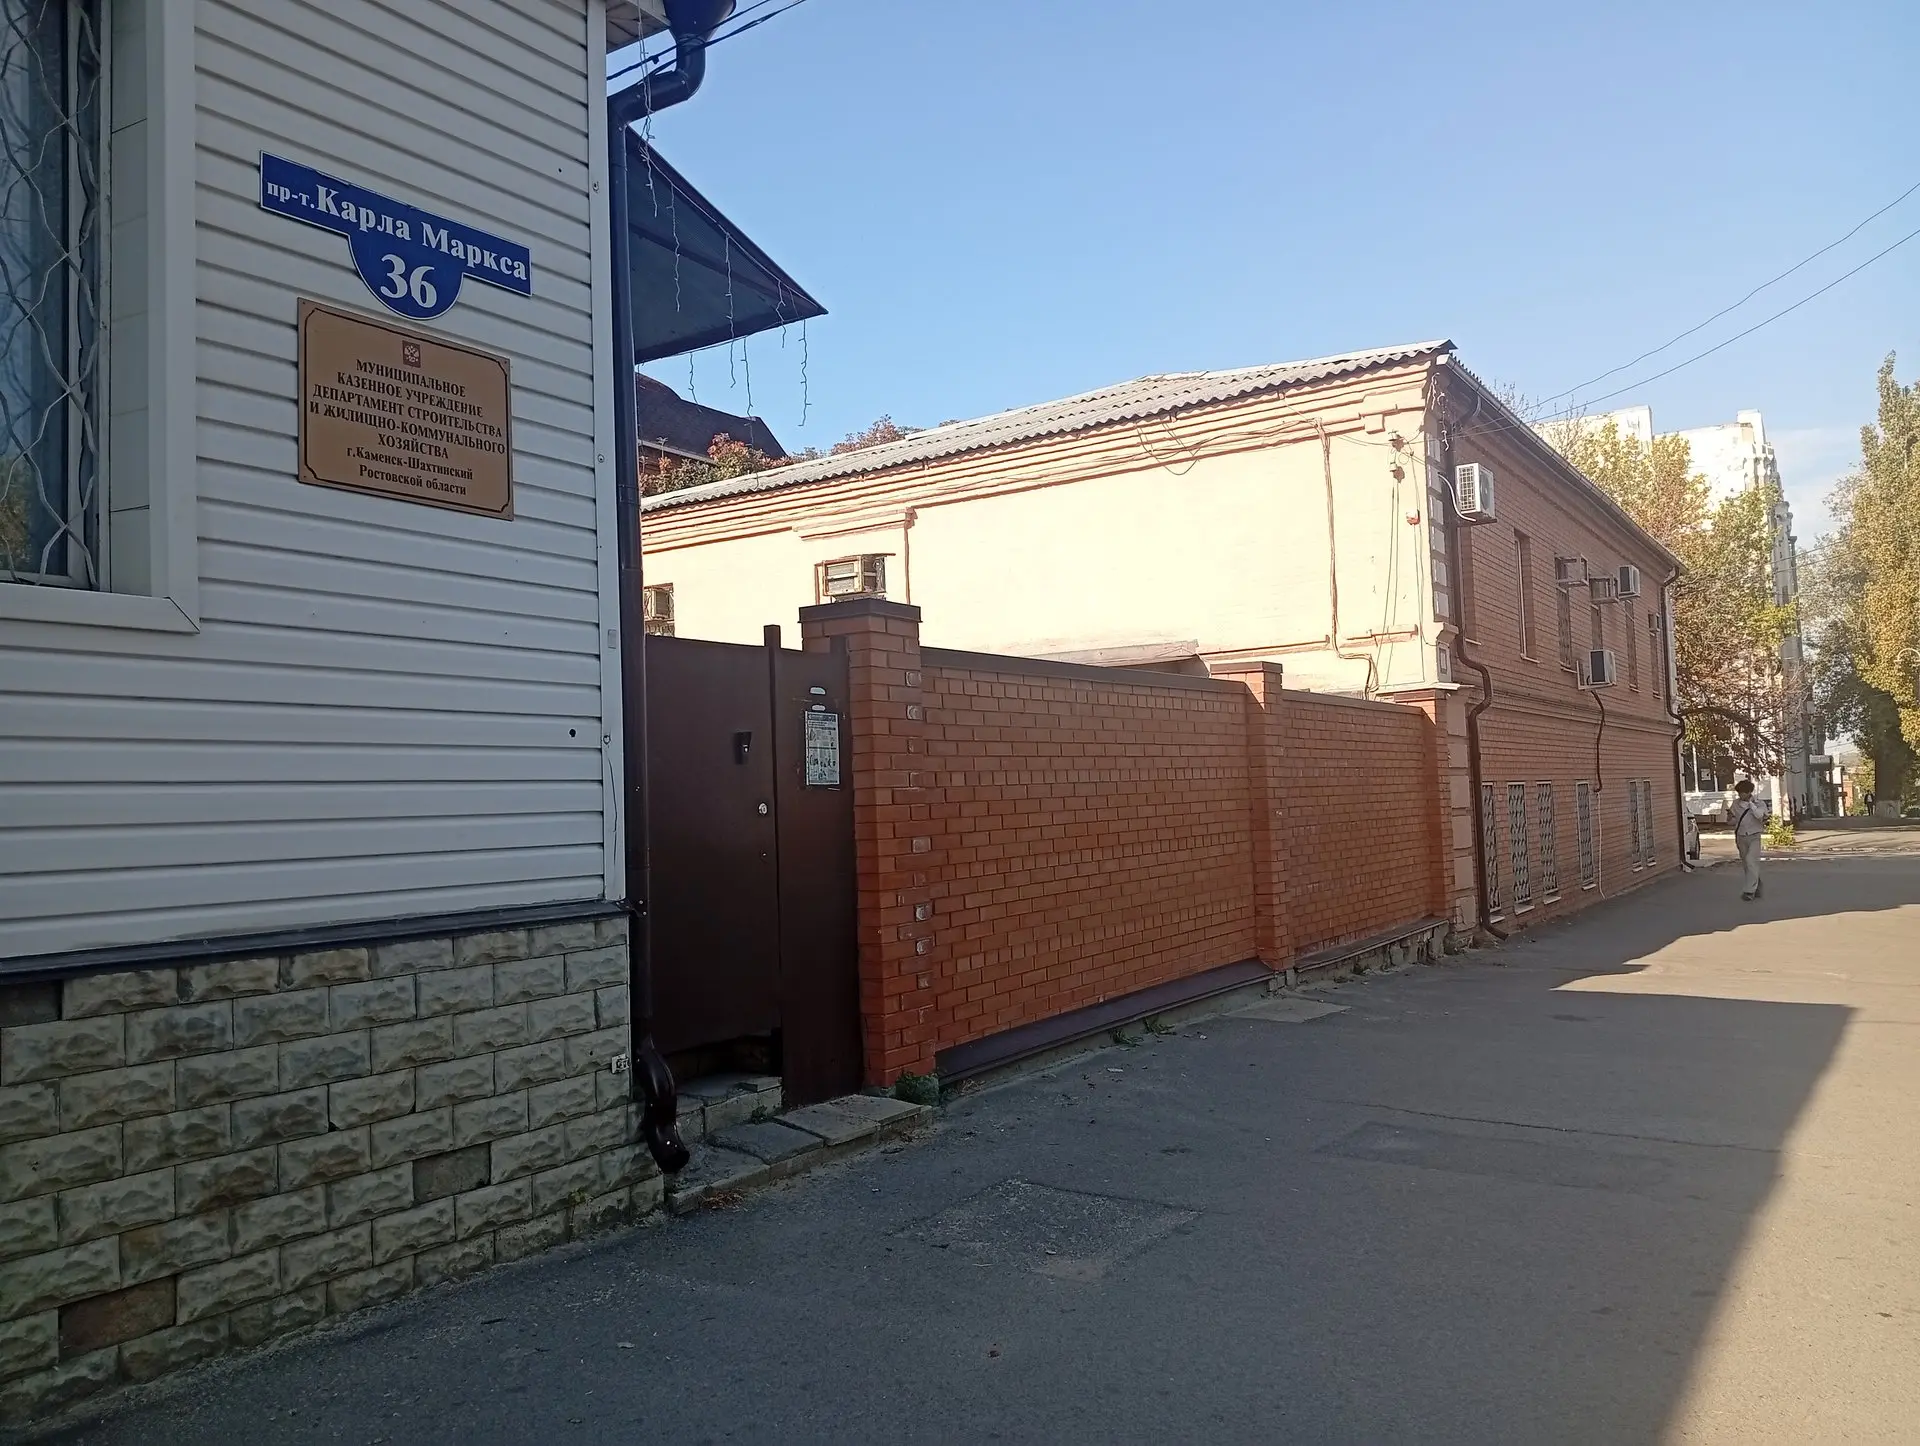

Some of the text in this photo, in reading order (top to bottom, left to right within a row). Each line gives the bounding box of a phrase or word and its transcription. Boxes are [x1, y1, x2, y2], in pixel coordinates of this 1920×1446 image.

[421, 221, 528, 280] Маркса
[380, 253, 438, 308] 36
[337, 371, 484, 417] КАЗЕННОЕ УЧРЕЖДЕНИЕ
[356, 359, 466, 398] МУНИЦИПАЛЬНОЕ
[310, 401, 506, 455] И ЖИЛИЩНО-КОММУНАЛЬНОГО
[313, 383, 502, 437] ДЕПАРТАМЕНТ СТРОИТЕЛЬСТВА
[378, 433, 449, 459] ХОЗЯЙСТВА
[359, 464, 467, 496] Ростовской области
